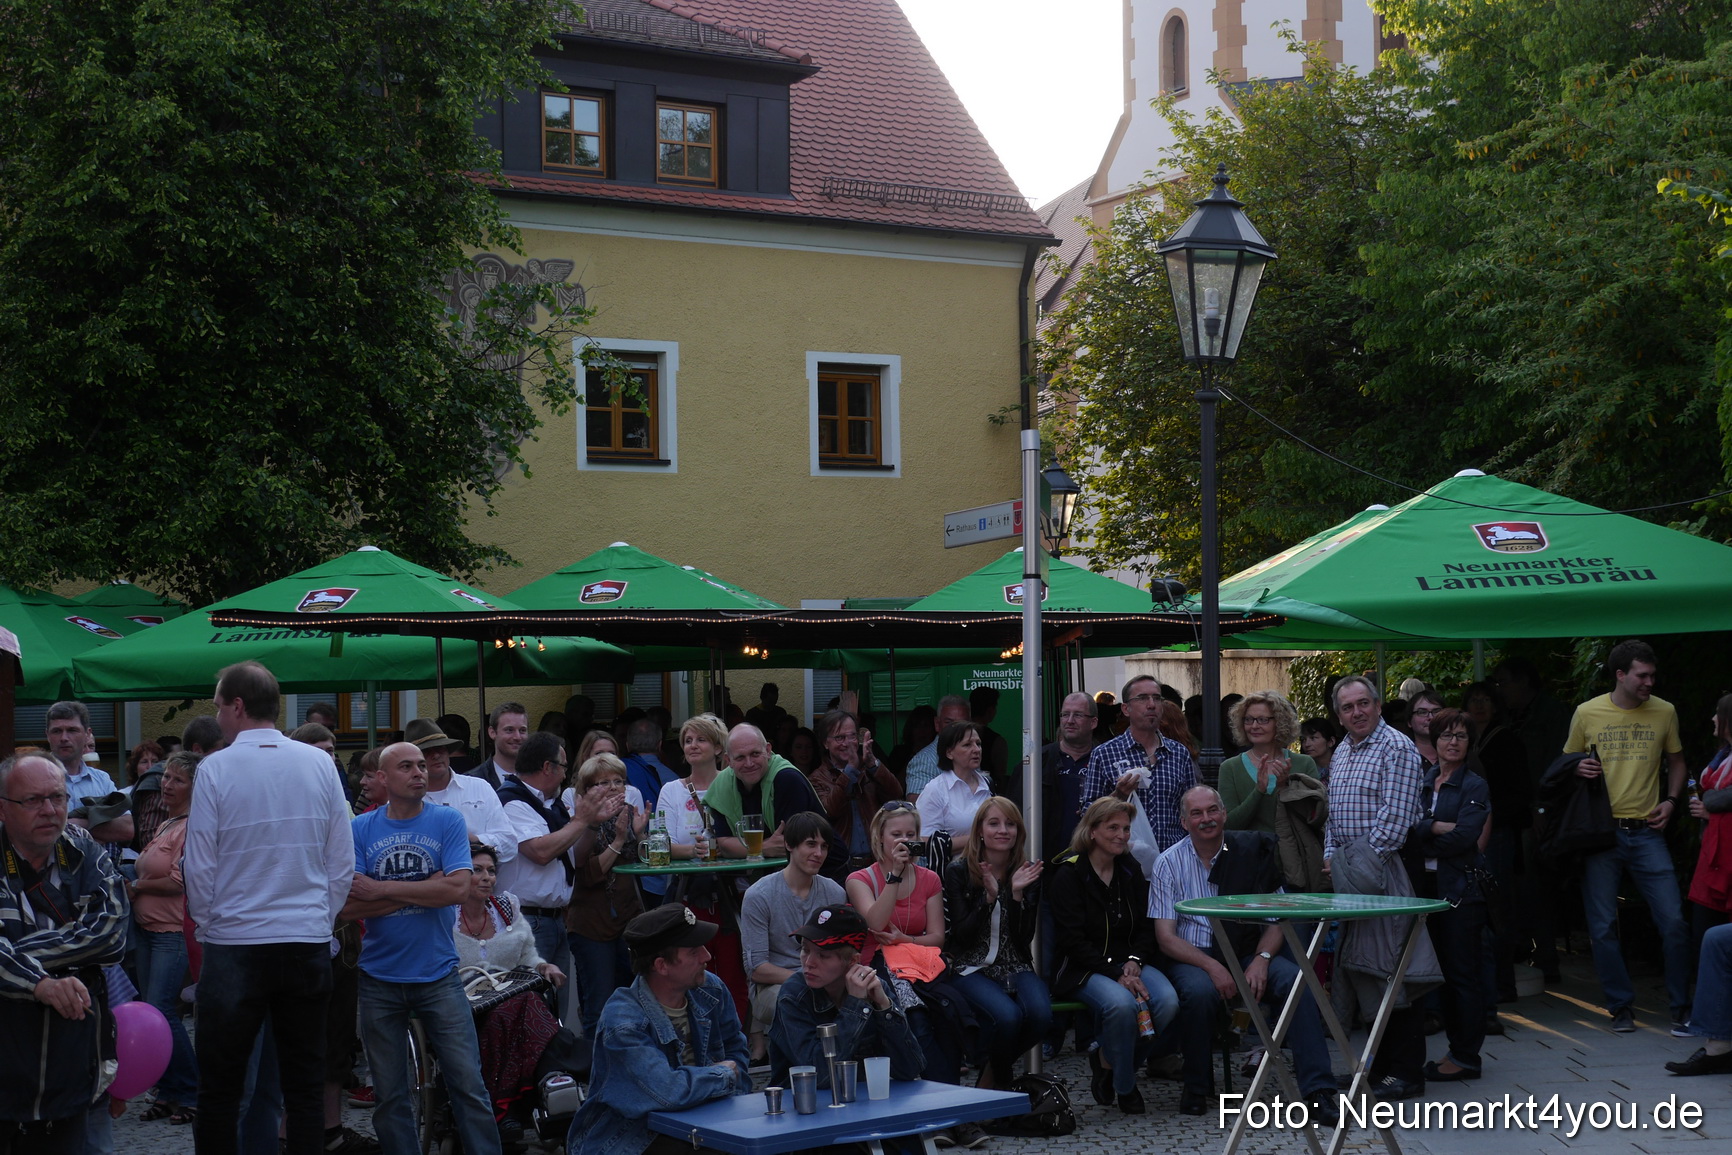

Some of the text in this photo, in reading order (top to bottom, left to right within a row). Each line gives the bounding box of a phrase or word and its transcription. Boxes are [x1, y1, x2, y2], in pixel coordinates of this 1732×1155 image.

[955, 522, 977, 533] Rathaus
[1442, 557, 1614, 574] Neumarkter
[1416, 566, 1658, 591] Lammsbräu
[972, 668, 1024, 678] Neumarkte
[1597, 730, 1656, 742] CASUAL WEAR
[1602, 742, 1635, 750] S.OLIVER
[5, 850, 17, 874] Nikon
